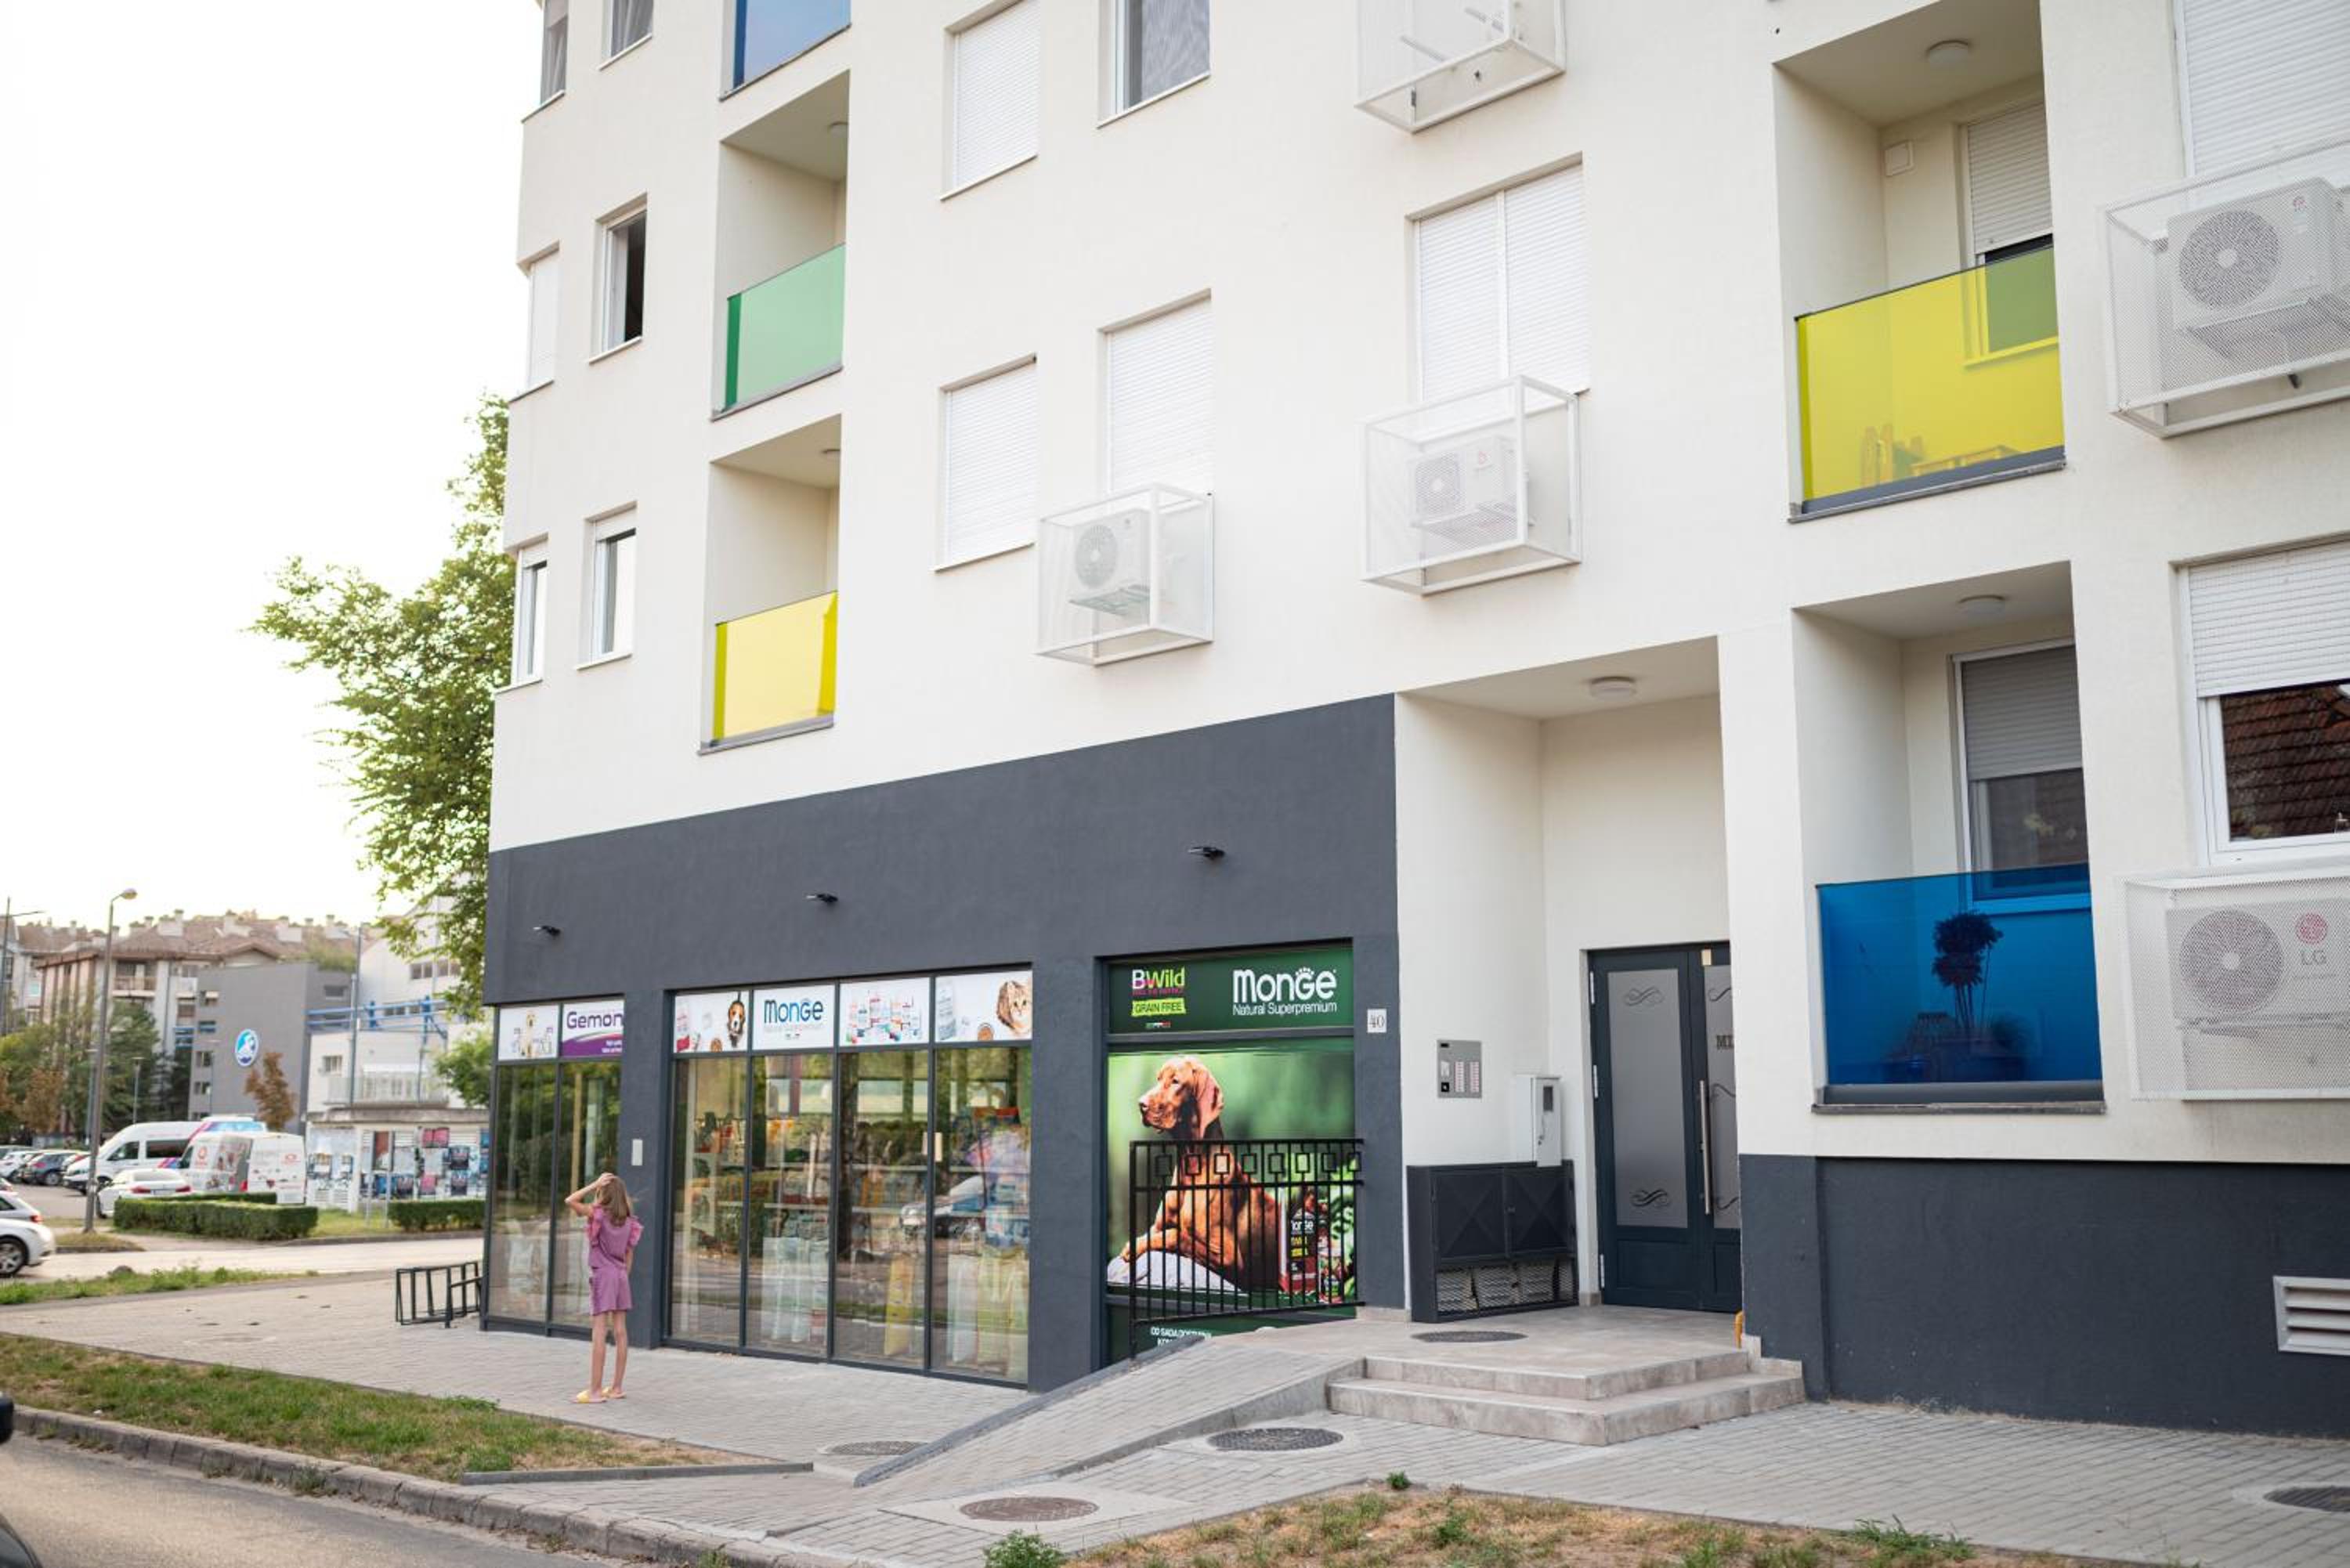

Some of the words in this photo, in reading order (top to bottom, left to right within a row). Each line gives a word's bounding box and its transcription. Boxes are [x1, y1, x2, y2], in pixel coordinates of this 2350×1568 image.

[2301, 949, 2327, 966] LG
[1135, 1003, 1159, 1013] GRAIN
[1162, 1002, 1182, 1012] FREE
[1233, 1003, 1265, 1016] Natural
[1267, 1002, 1337, 1016] Superpremium
[1368, 1014, 1385, 1028] 40
